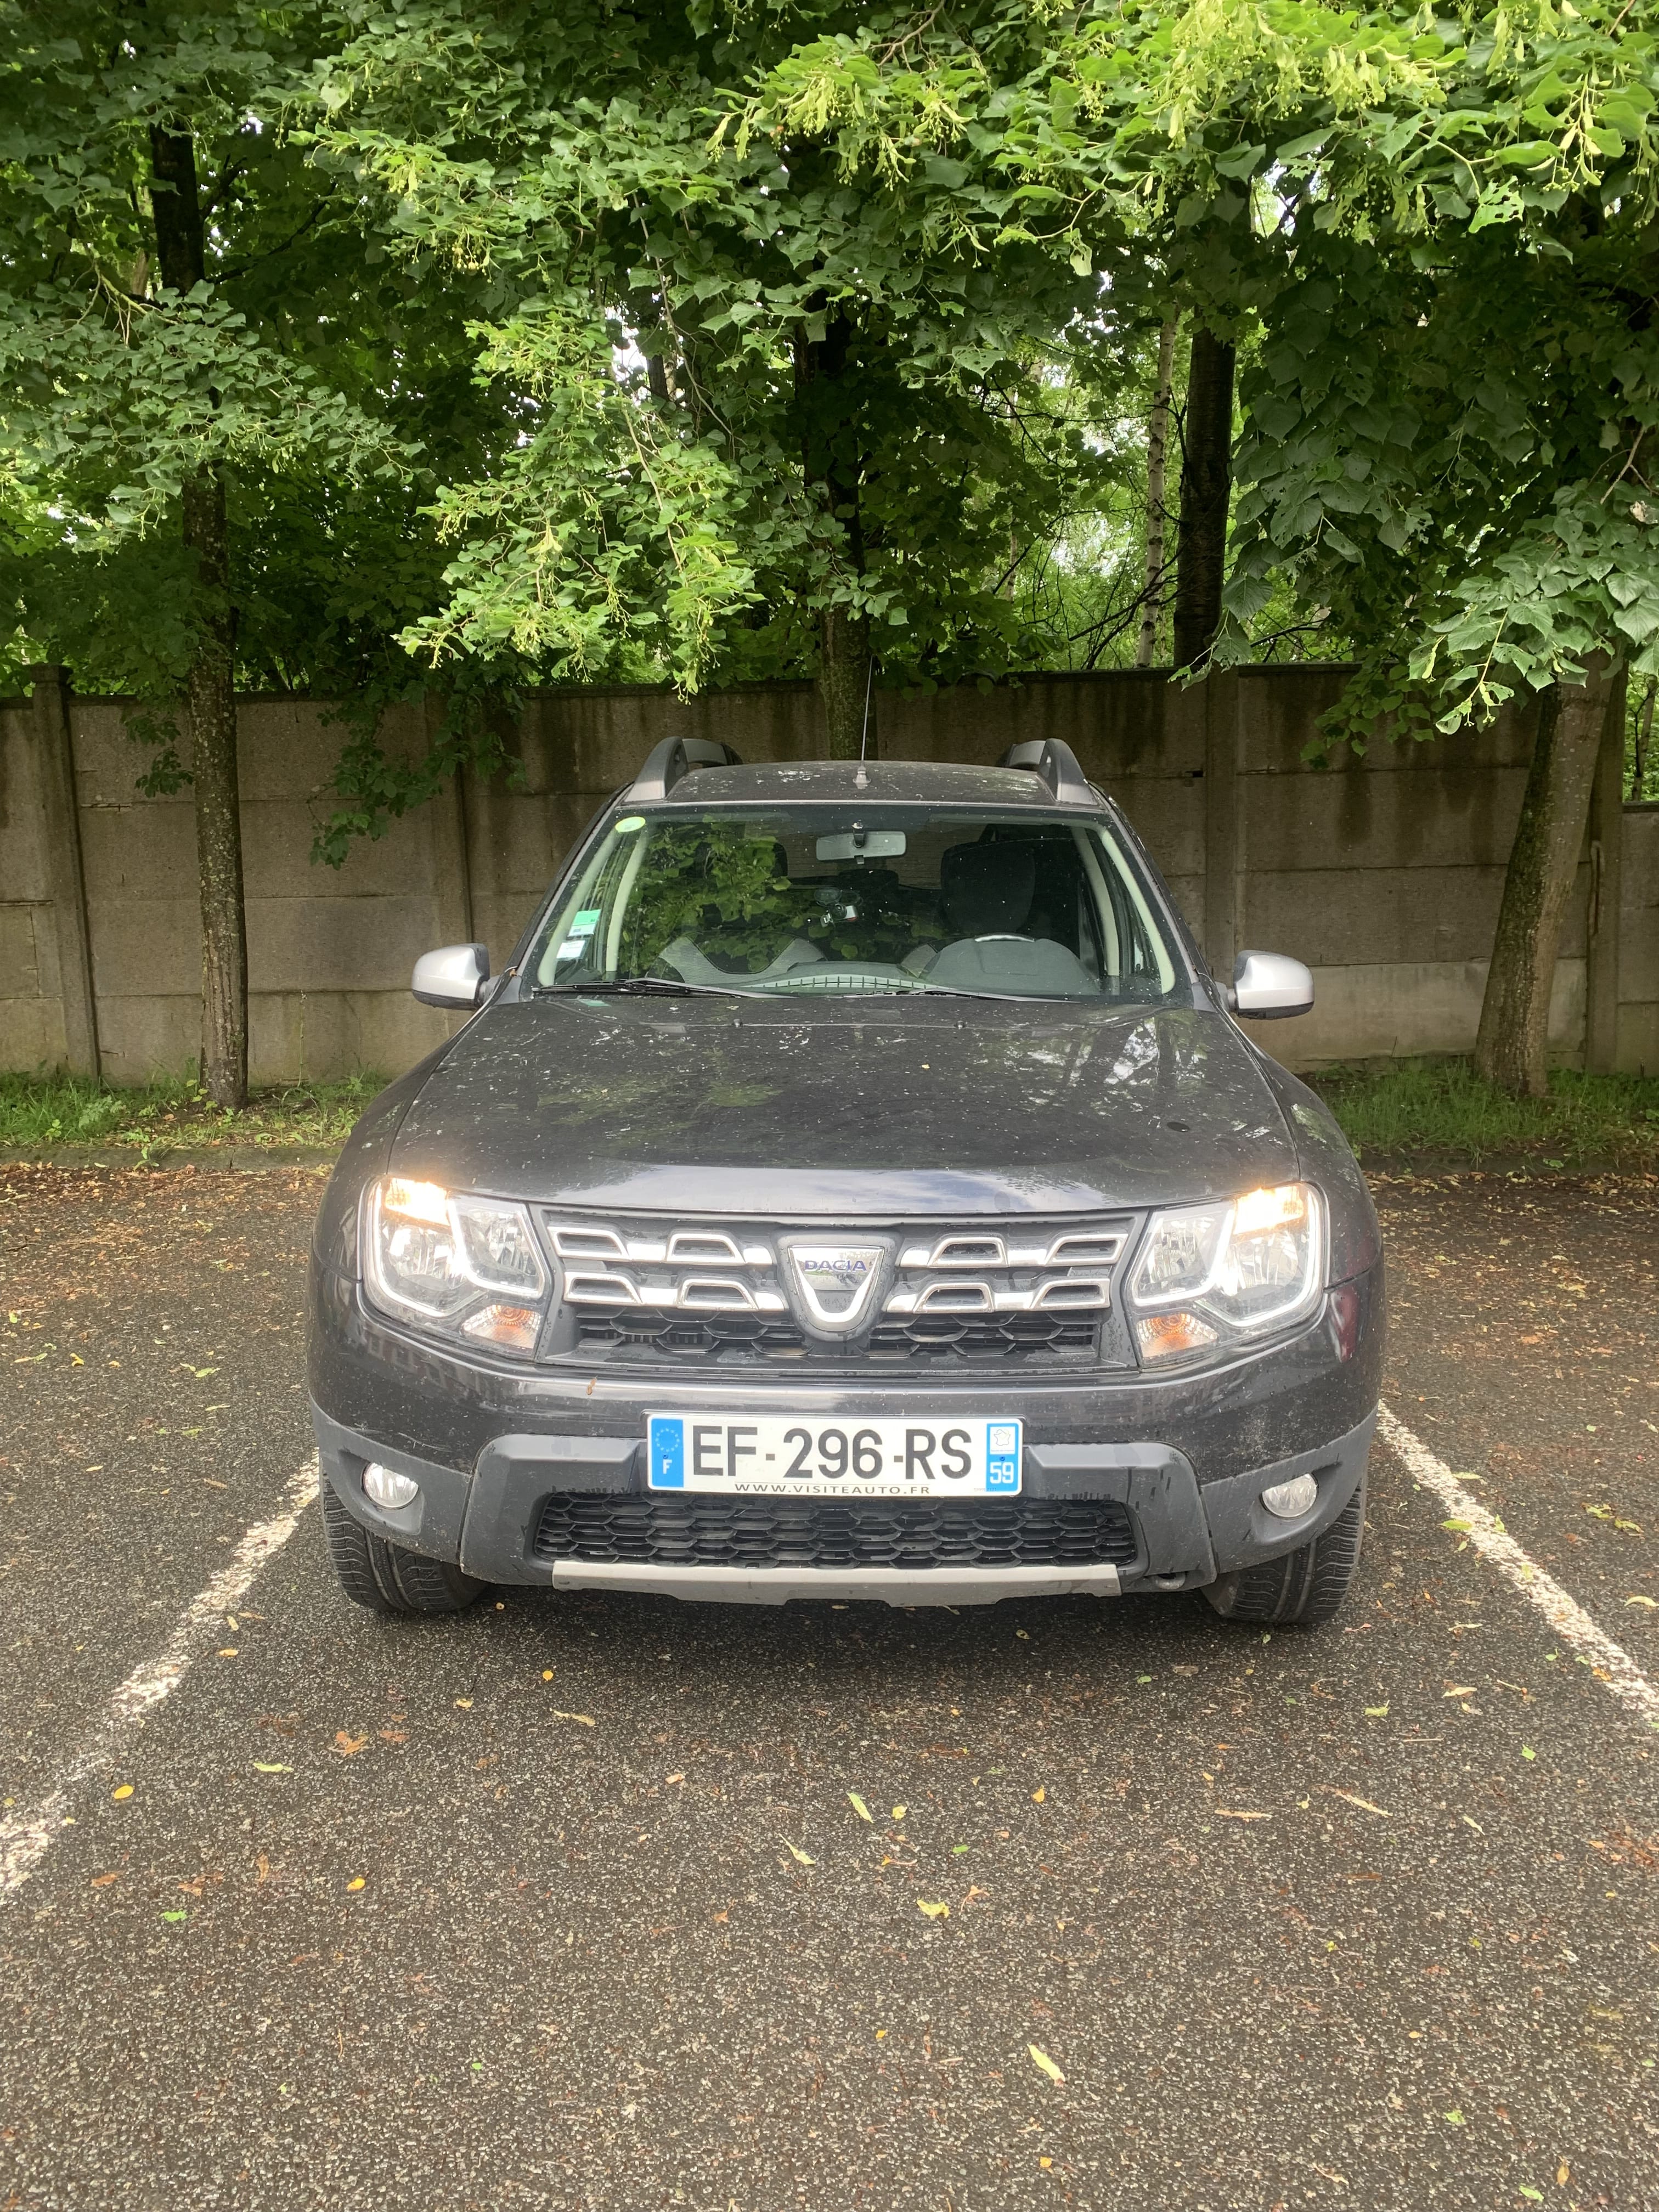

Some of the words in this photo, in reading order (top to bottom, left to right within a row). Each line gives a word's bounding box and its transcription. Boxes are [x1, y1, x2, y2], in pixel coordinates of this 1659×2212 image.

[805, 1260, 867, 1271] DACIA
[693, 1425, 972, 1479] EF-296-RS
[663, 1459, 672, 1474] F
[990, 1462, 1014, 1483] 59
[735, 1483, 929, 1494] WWW.VISITEAUTO.FR
